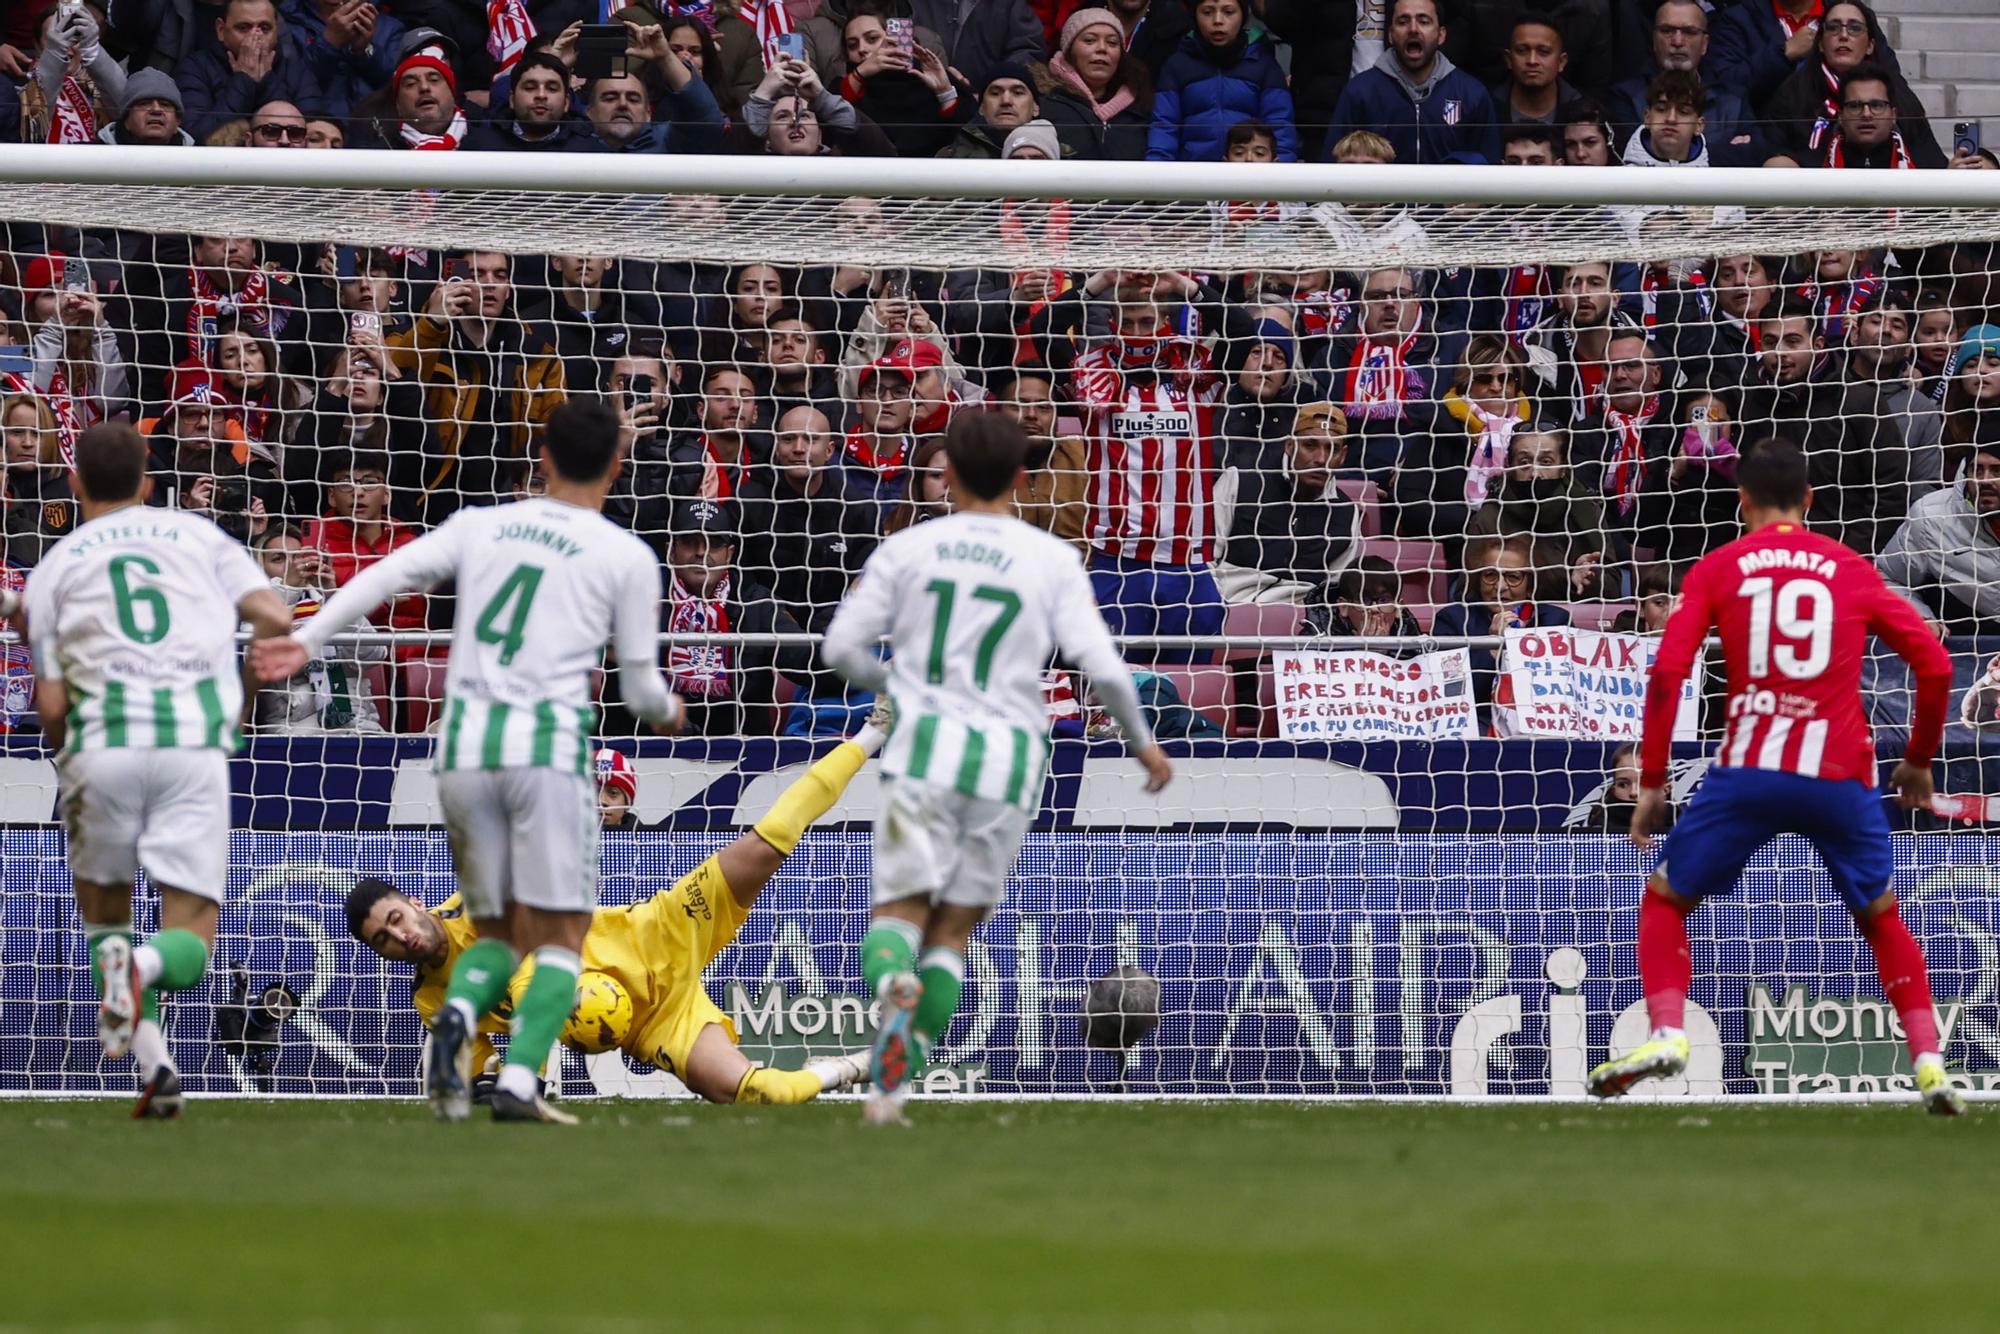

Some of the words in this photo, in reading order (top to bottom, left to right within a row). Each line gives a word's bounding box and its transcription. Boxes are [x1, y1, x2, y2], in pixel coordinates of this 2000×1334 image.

[1114, 415, 1187, 431] Plus500
[494, 521, 583, 558] JOHNNY
[1737, 549, 1837, 579] MORATA
[109, 553, 170, 644] 6
[475, 563, 545, 667] 4
[924, 578, 1022, 692] 17
[1737, 576, 1834, 679] 19
[1314, 657, 1422, 682] HERMOSO
[1519, 631, 1640, 674] OBLAK
[1284, 682, 1346, 703] ERES
[1354, 682, 1377, 697] EL
[1380, 684, 1442, 705] MEJOR
[1729, 683, 1776, 717] ria
[1282, 703, 1310, 720] TE
[1316, 700, 1387, 717] CAMBIO
[1391, 707, 1411, 723] TU
[1415, 701, 1470, 722] CROMO
[1286, 720, 1320, 735] POR
[1326, 718, 1347, 733] TU
[1353, 717, 1426, 737] CAMISETA
[1446, 717, 1469, 730] LA
[692, 872, 712, 920] GLOBAL
